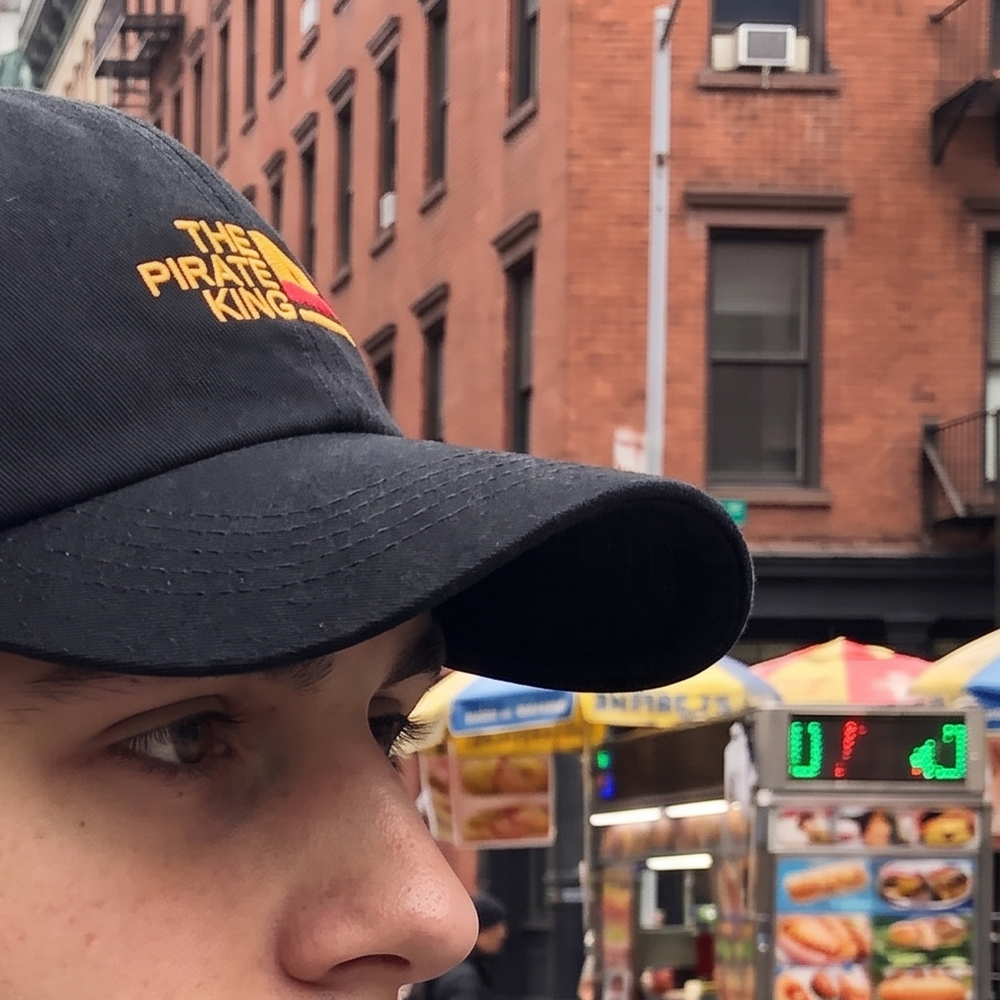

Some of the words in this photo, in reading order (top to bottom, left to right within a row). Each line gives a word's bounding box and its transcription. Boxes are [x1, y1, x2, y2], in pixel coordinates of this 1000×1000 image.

[173, 219, 260, 259] THE
[136, 254, 280, 297] PIRATE
[202, 287, 298, 323] KING
